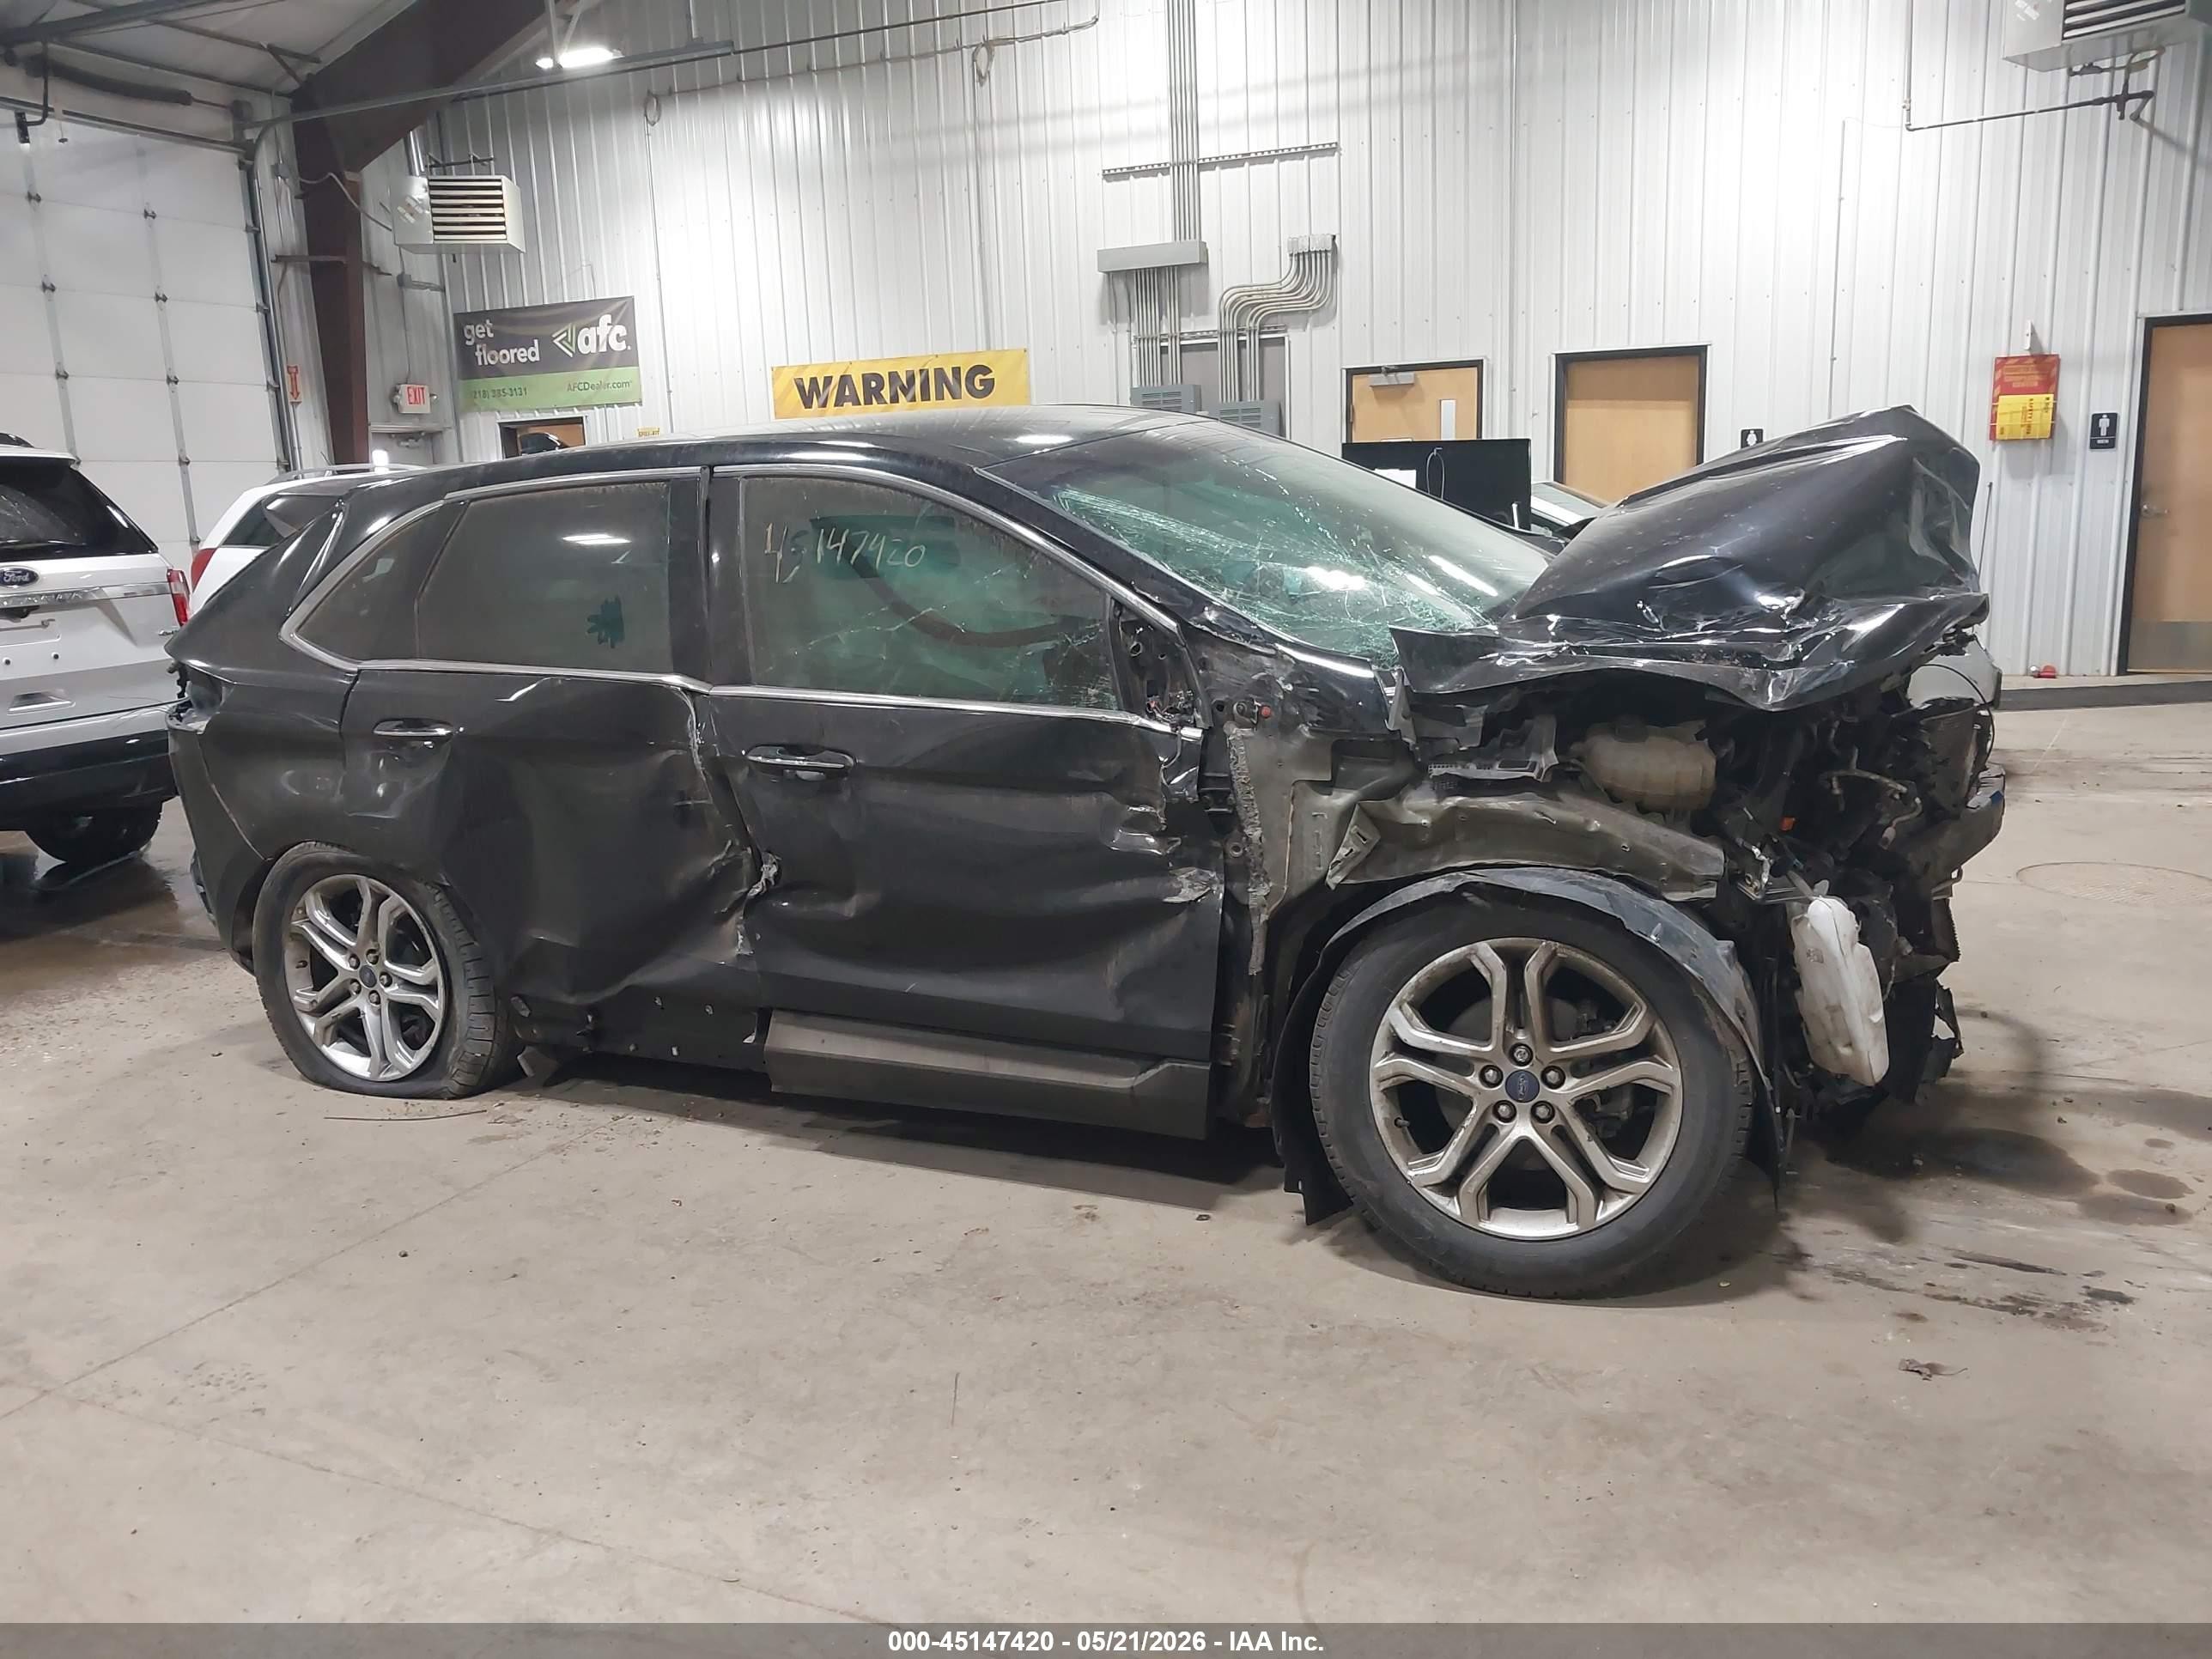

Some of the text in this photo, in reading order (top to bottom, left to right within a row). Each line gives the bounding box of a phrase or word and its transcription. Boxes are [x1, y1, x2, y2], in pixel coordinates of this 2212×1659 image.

[464, 319, 494, 345] get
[475, 339, 539, 365] floored
[407, 386, 425, 404] EXIT
[793, 365, 995, 409] WARNING
[3, 570, 29, 582] Ford
